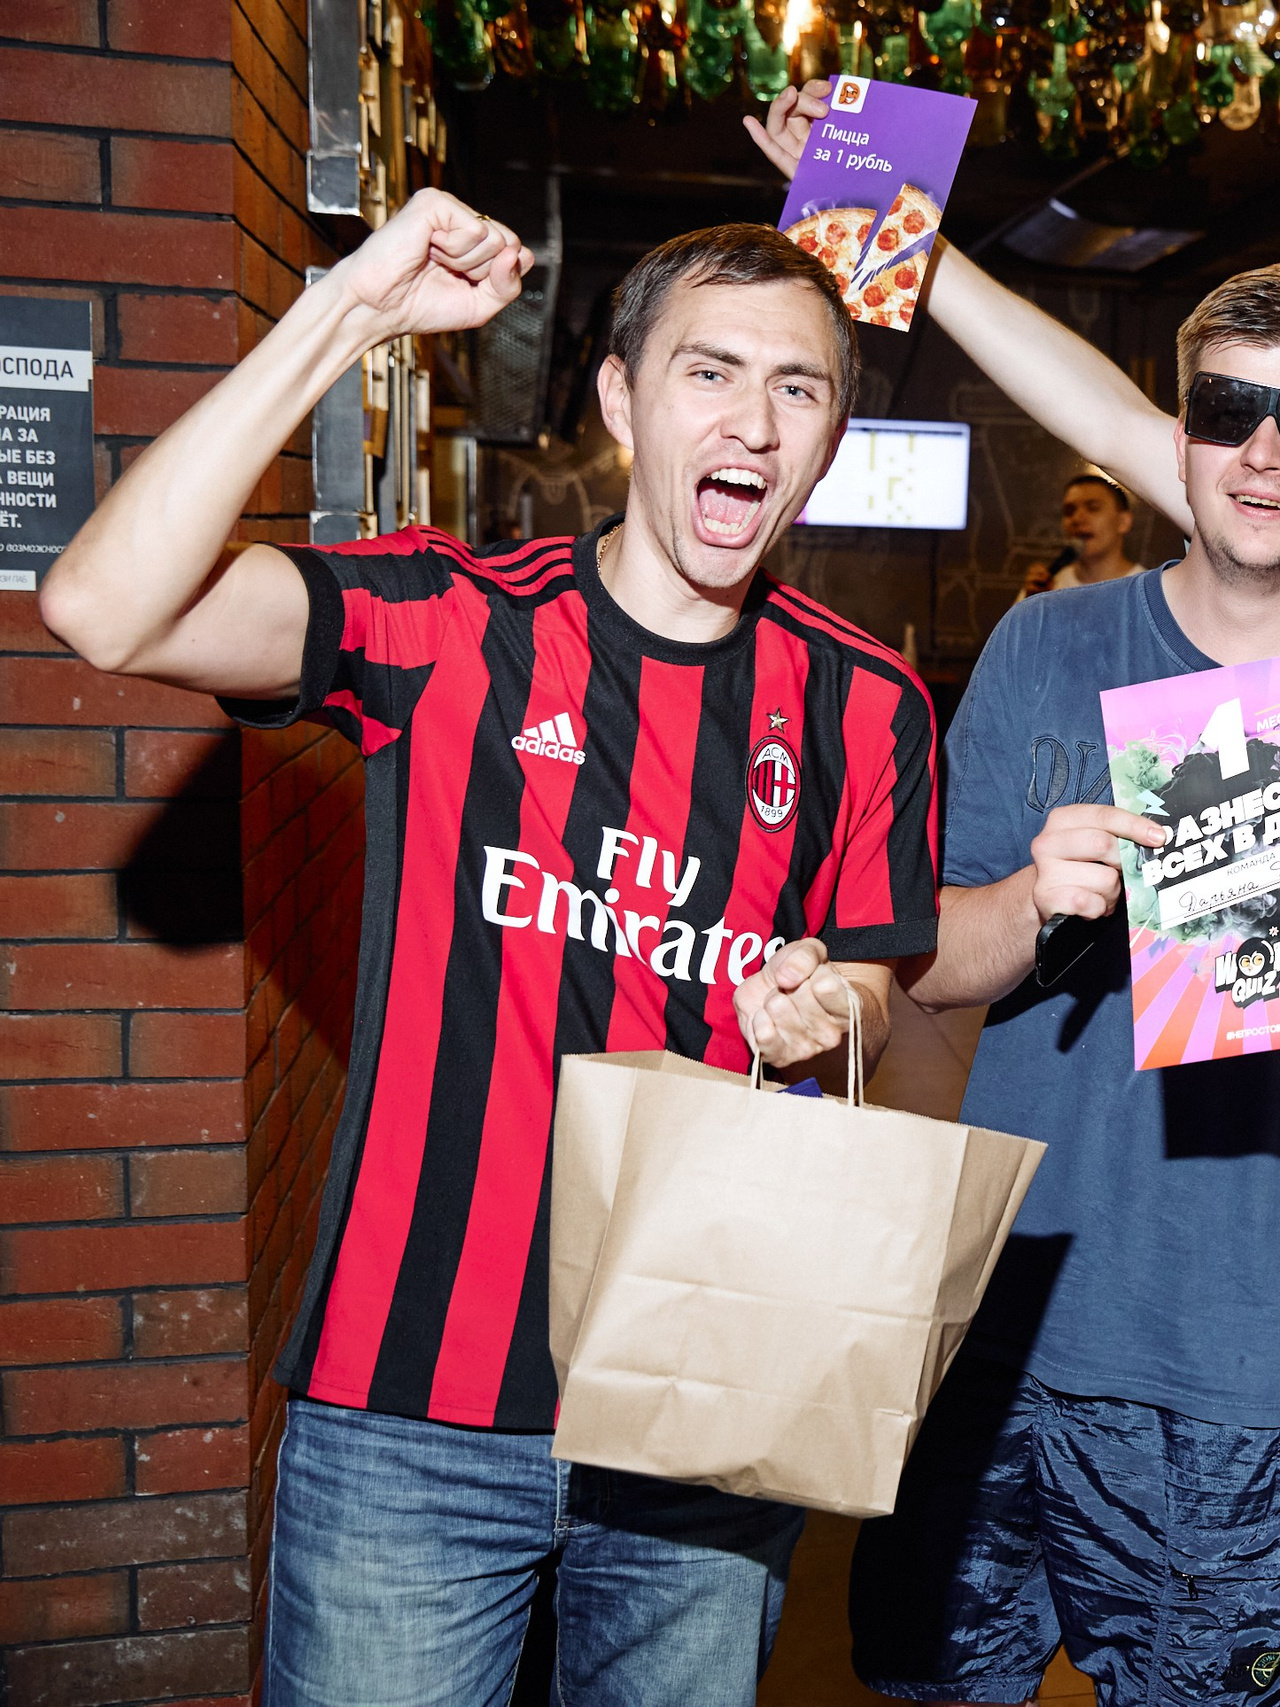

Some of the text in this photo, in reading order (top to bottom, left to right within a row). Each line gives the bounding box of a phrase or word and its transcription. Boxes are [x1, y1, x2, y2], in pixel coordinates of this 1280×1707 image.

[821, 123, 870, 146] Пицца
[813, 147, 893, 173] за 1 рубль
[0, 356, 74, 381] СПОДА
[17, 427, 39, 442] ЗА
[25, 449, 56, 465] БЕЗ
[7, 470, 55, 489] ВЕЩИ
[511, 735, 587, 766] adidas
[1199, 697, 1250, 780] 1
[762, 746, 789, 766] ACM
[760, 805, 783, 818] 1899
[596, 825, 701, 907] Fly
[1141, 831, 1229, 888] ВСЕХ
[1231, 823, 1256, 854] В
[1226, 851, 1277, 877] КОМАНДА
[1231, 970, 1279, 1003] QUIZ
